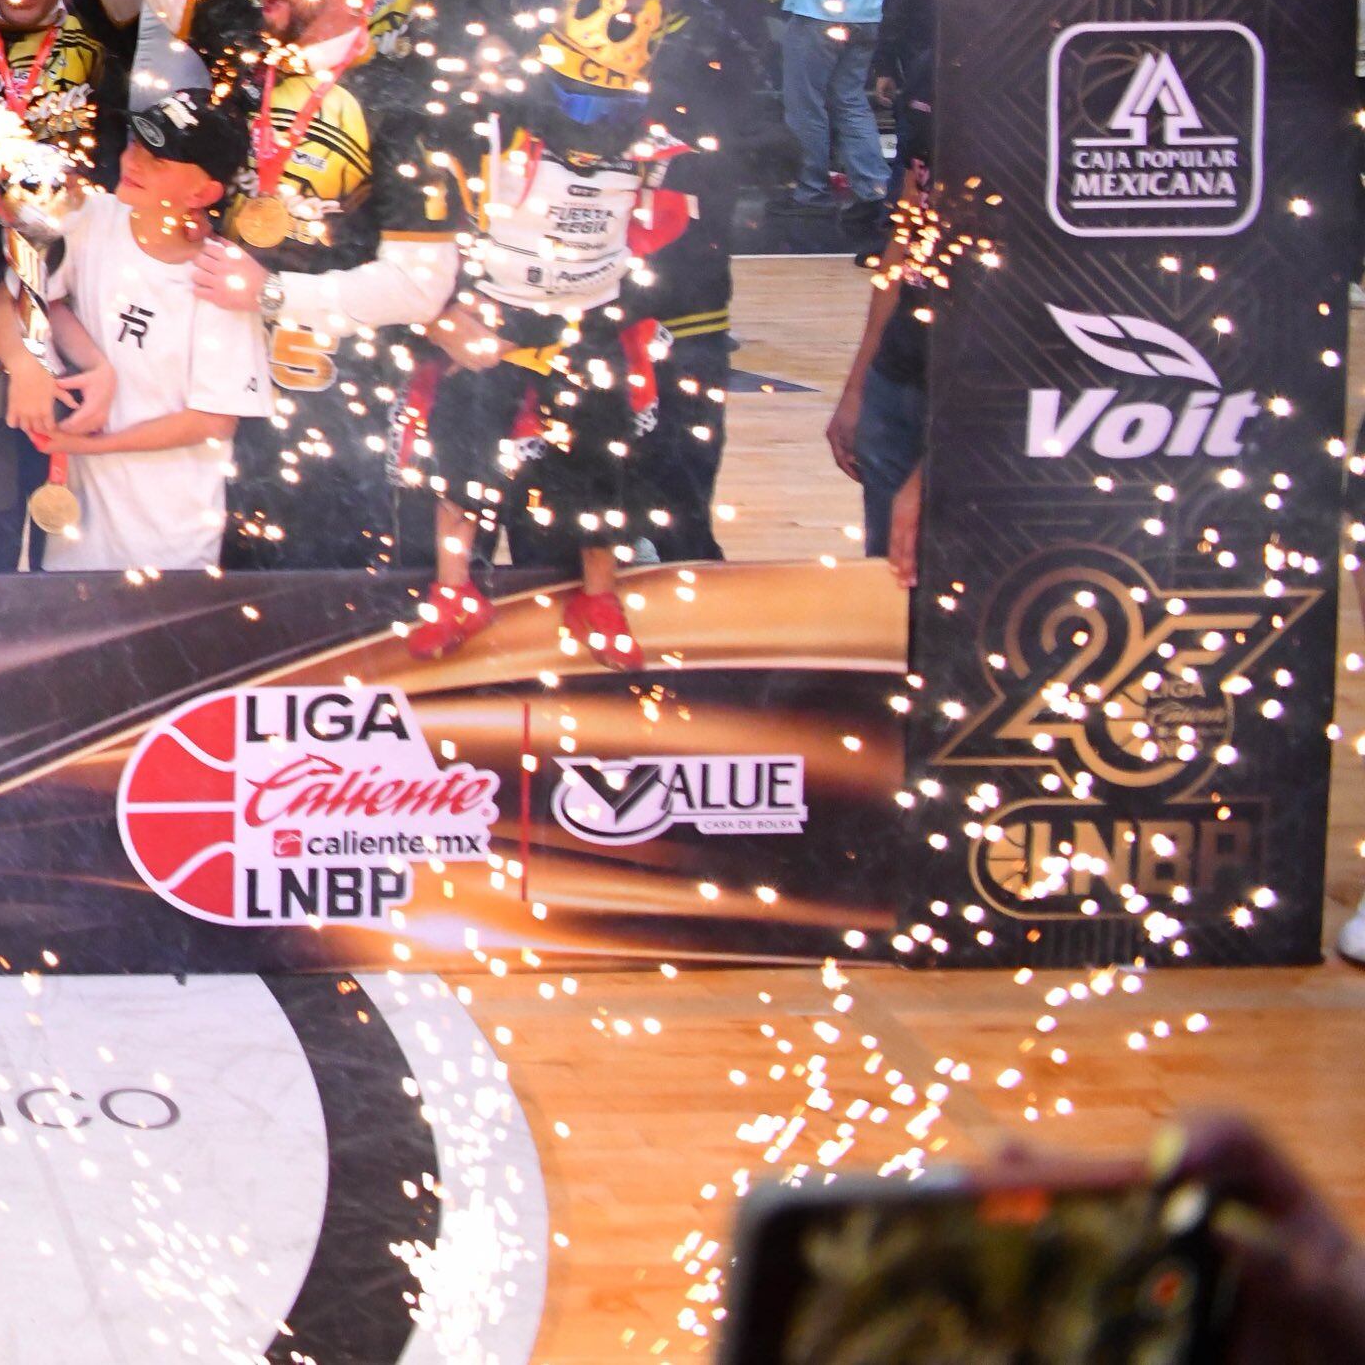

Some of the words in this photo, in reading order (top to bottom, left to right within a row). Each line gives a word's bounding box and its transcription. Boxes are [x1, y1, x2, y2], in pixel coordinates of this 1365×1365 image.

[1071, 149, 1132, 172] CAJA
[1135, 148, 1238, 169] POPULAR
[1071, 171, 1237, 197] MEXICANA
[1026, 387, 1263, 459] Voit
[245, 693, 412, 744] LIGA
[243, 752, 489, 831] Caliente
[555, 762, 797, 843] VALUE
[307, 831, 482, 857] caliente.mx
[245, 866, 409, 919] LNBP
